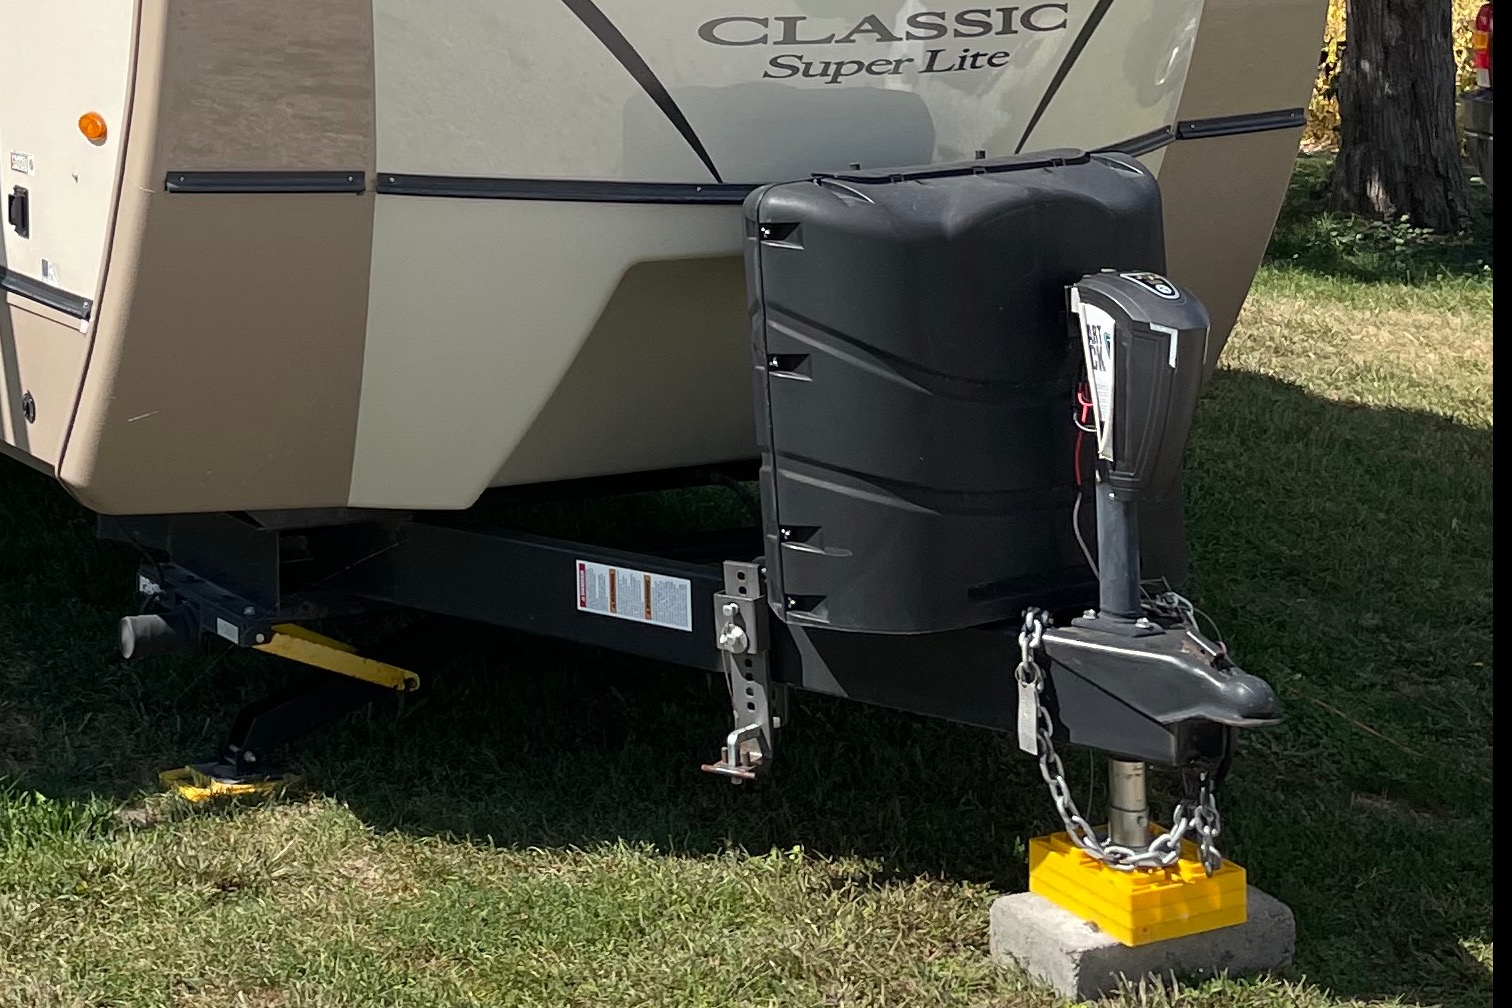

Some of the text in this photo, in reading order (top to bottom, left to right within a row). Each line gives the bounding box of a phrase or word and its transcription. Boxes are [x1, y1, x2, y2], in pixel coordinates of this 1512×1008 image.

[697, 2, 1069, 46] CLASSIC
[762, 48, 1010, 84] Super Lite
